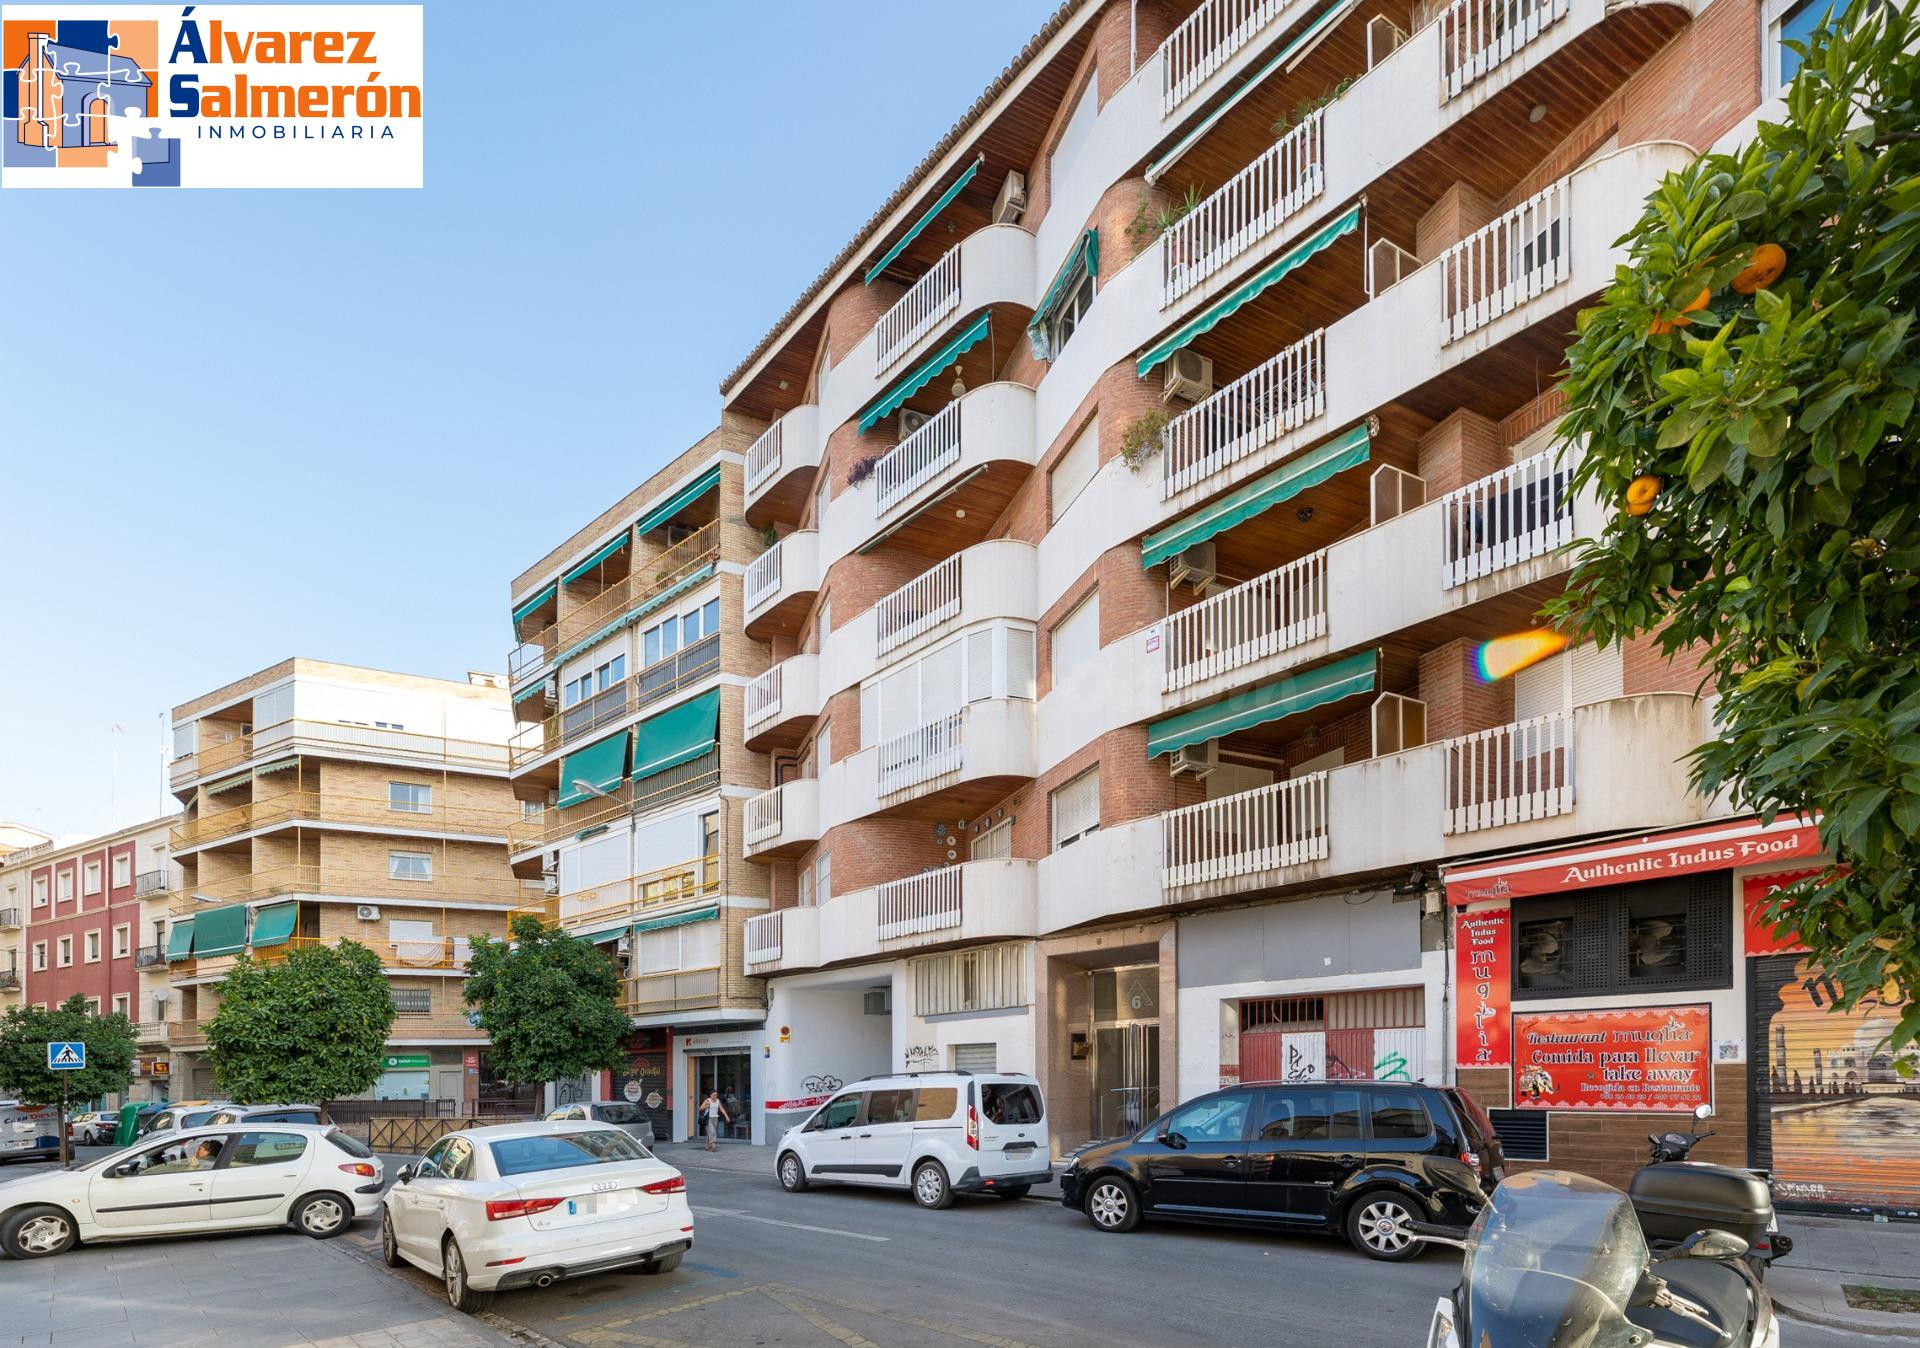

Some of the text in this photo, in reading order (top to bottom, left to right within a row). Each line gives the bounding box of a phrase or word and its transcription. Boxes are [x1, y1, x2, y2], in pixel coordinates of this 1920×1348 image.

[1560, 833, 1799, 884] Authentic Indus Food
[1461, 918, 1505, 929] Authentic
[1471, 928, 1497, 937] Indus
[1472, 937, 1494, 945] Food
[1131, 995, 1142, 1009] 6
[1471, 949, 1496, 1062] muglia
[1527, 1024, 1693, 1045] Restaurant muglia
[1532, 1047, 1702, 1069] Comida para llevar
[1602, 1065, 1698, 1084] take away
